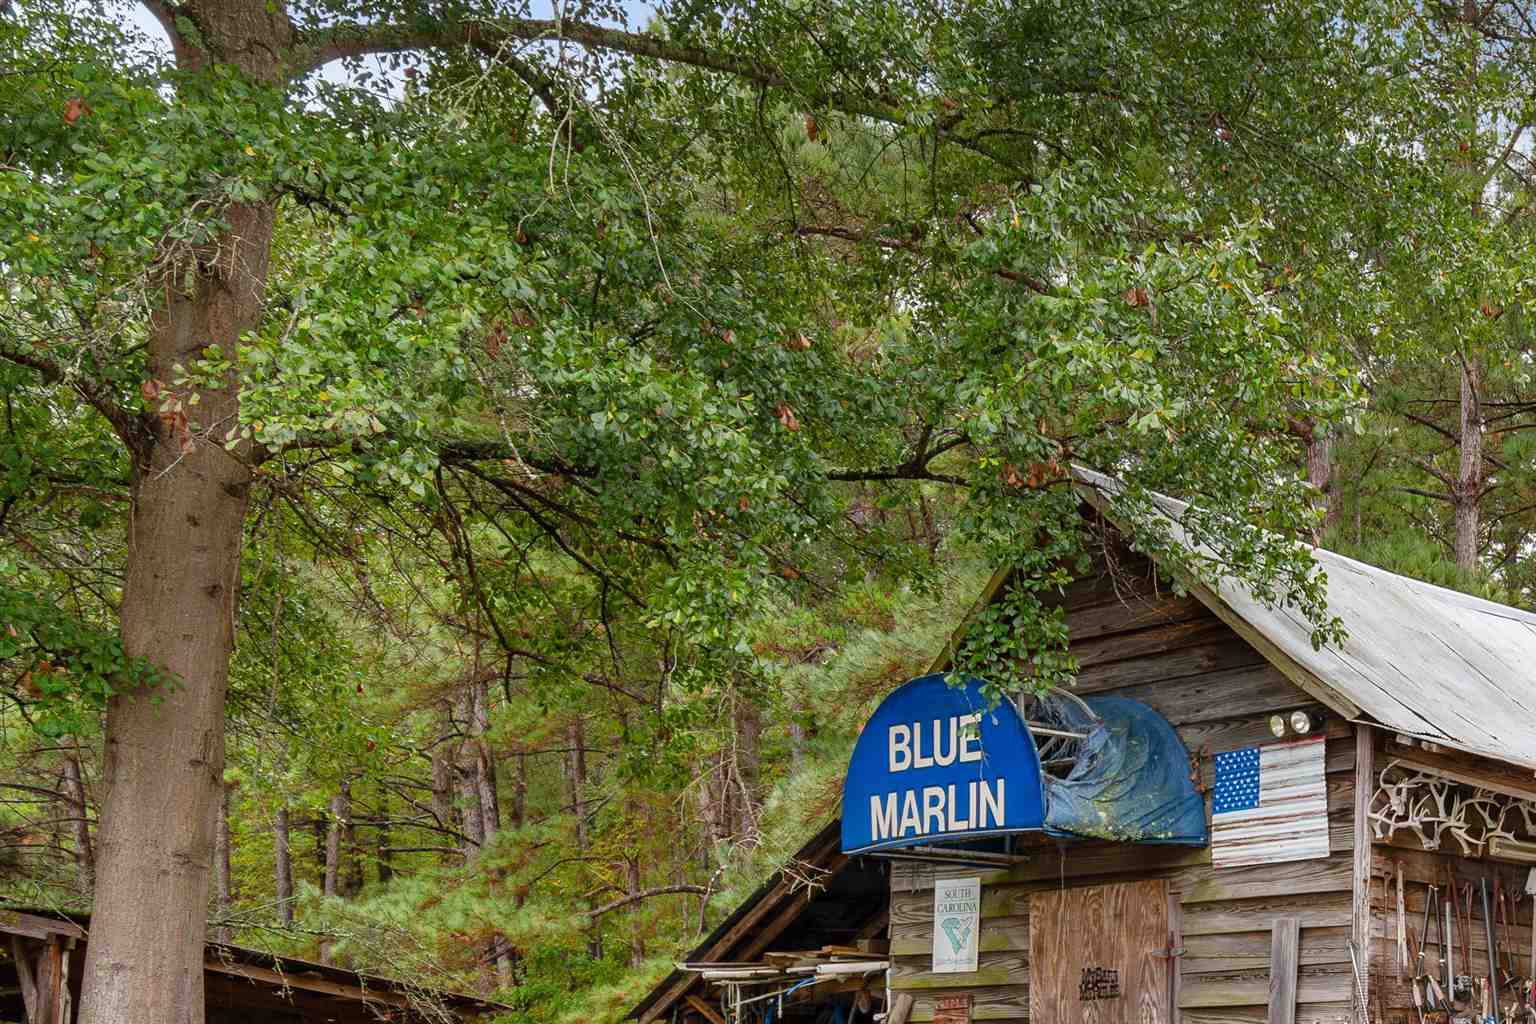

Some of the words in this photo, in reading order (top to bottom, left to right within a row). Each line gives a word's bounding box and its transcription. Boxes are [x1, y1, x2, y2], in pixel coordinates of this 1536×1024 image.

[888, 713, 982, 773] BLUE
[870, 778, 1006, 841] MARLIN
[936, 903, 977, 913] CAROLINA
[944, 888, 972, 898] SOUTH
